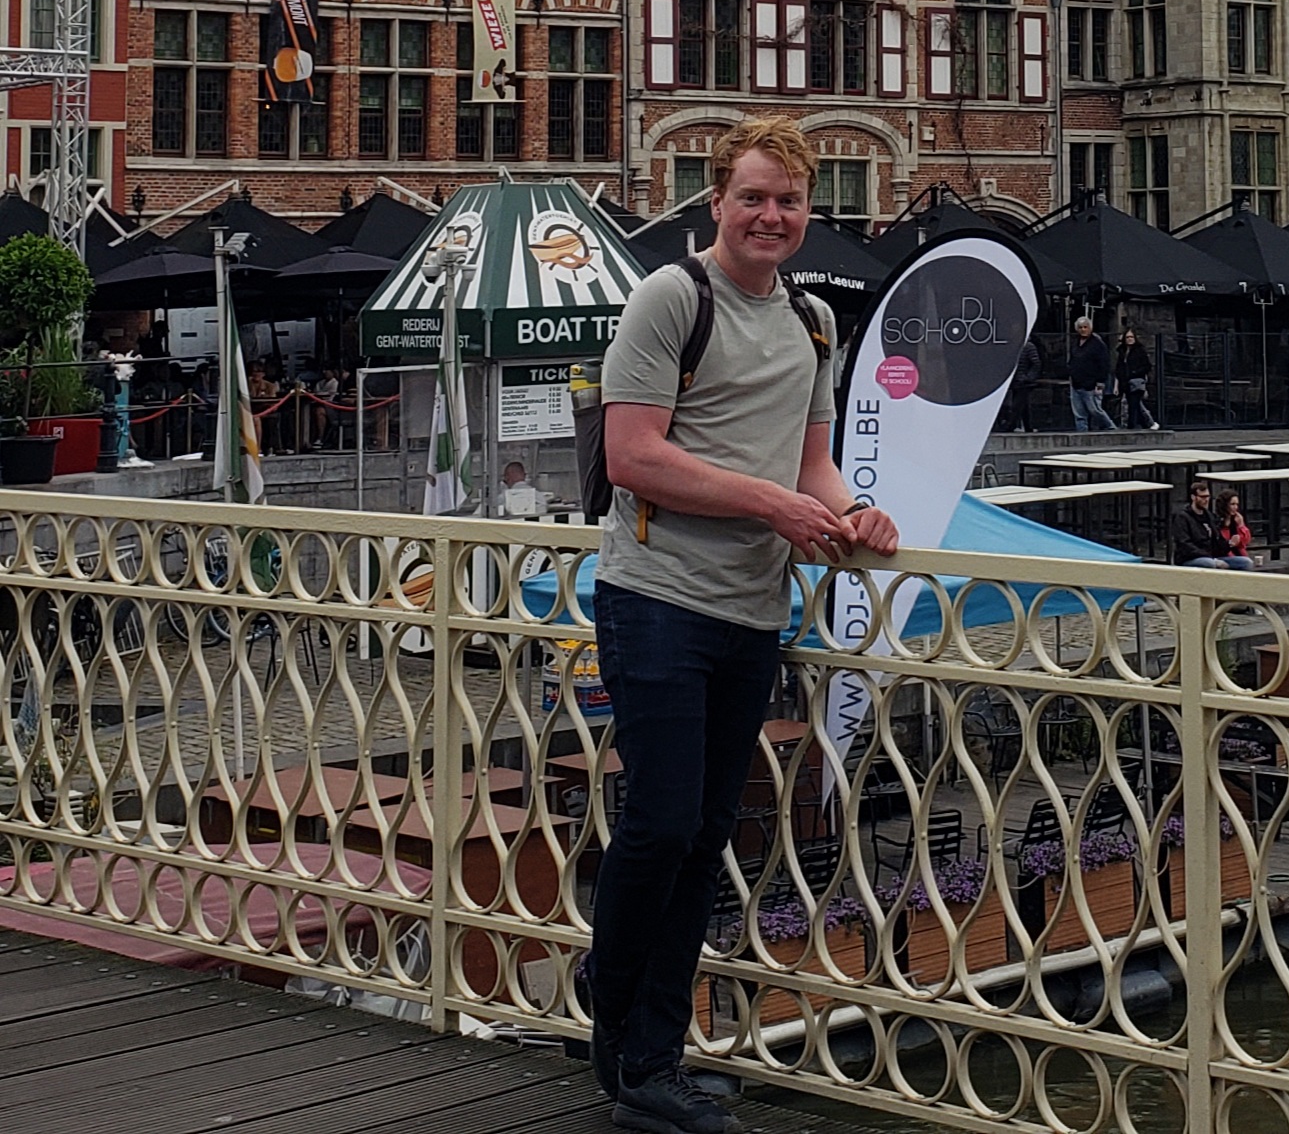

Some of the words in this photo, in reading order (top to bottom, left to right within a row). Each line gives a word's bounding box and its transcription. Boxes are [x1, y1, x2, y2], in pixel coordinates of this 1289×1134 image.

[481, 2, 504, 48] WIEZE
[791, 271, 826, 285] Witte
[827, 272, 865, 290] Leeuw
[961, 296, 993, 323] DJ
[402, 317, 440, 332] REDERIJ
[517, 316, 587, 345] BOAT
[884, 317, 1008, 344] SCHOOL
[376, 334, 470, 349] GENT-WATERTOST
